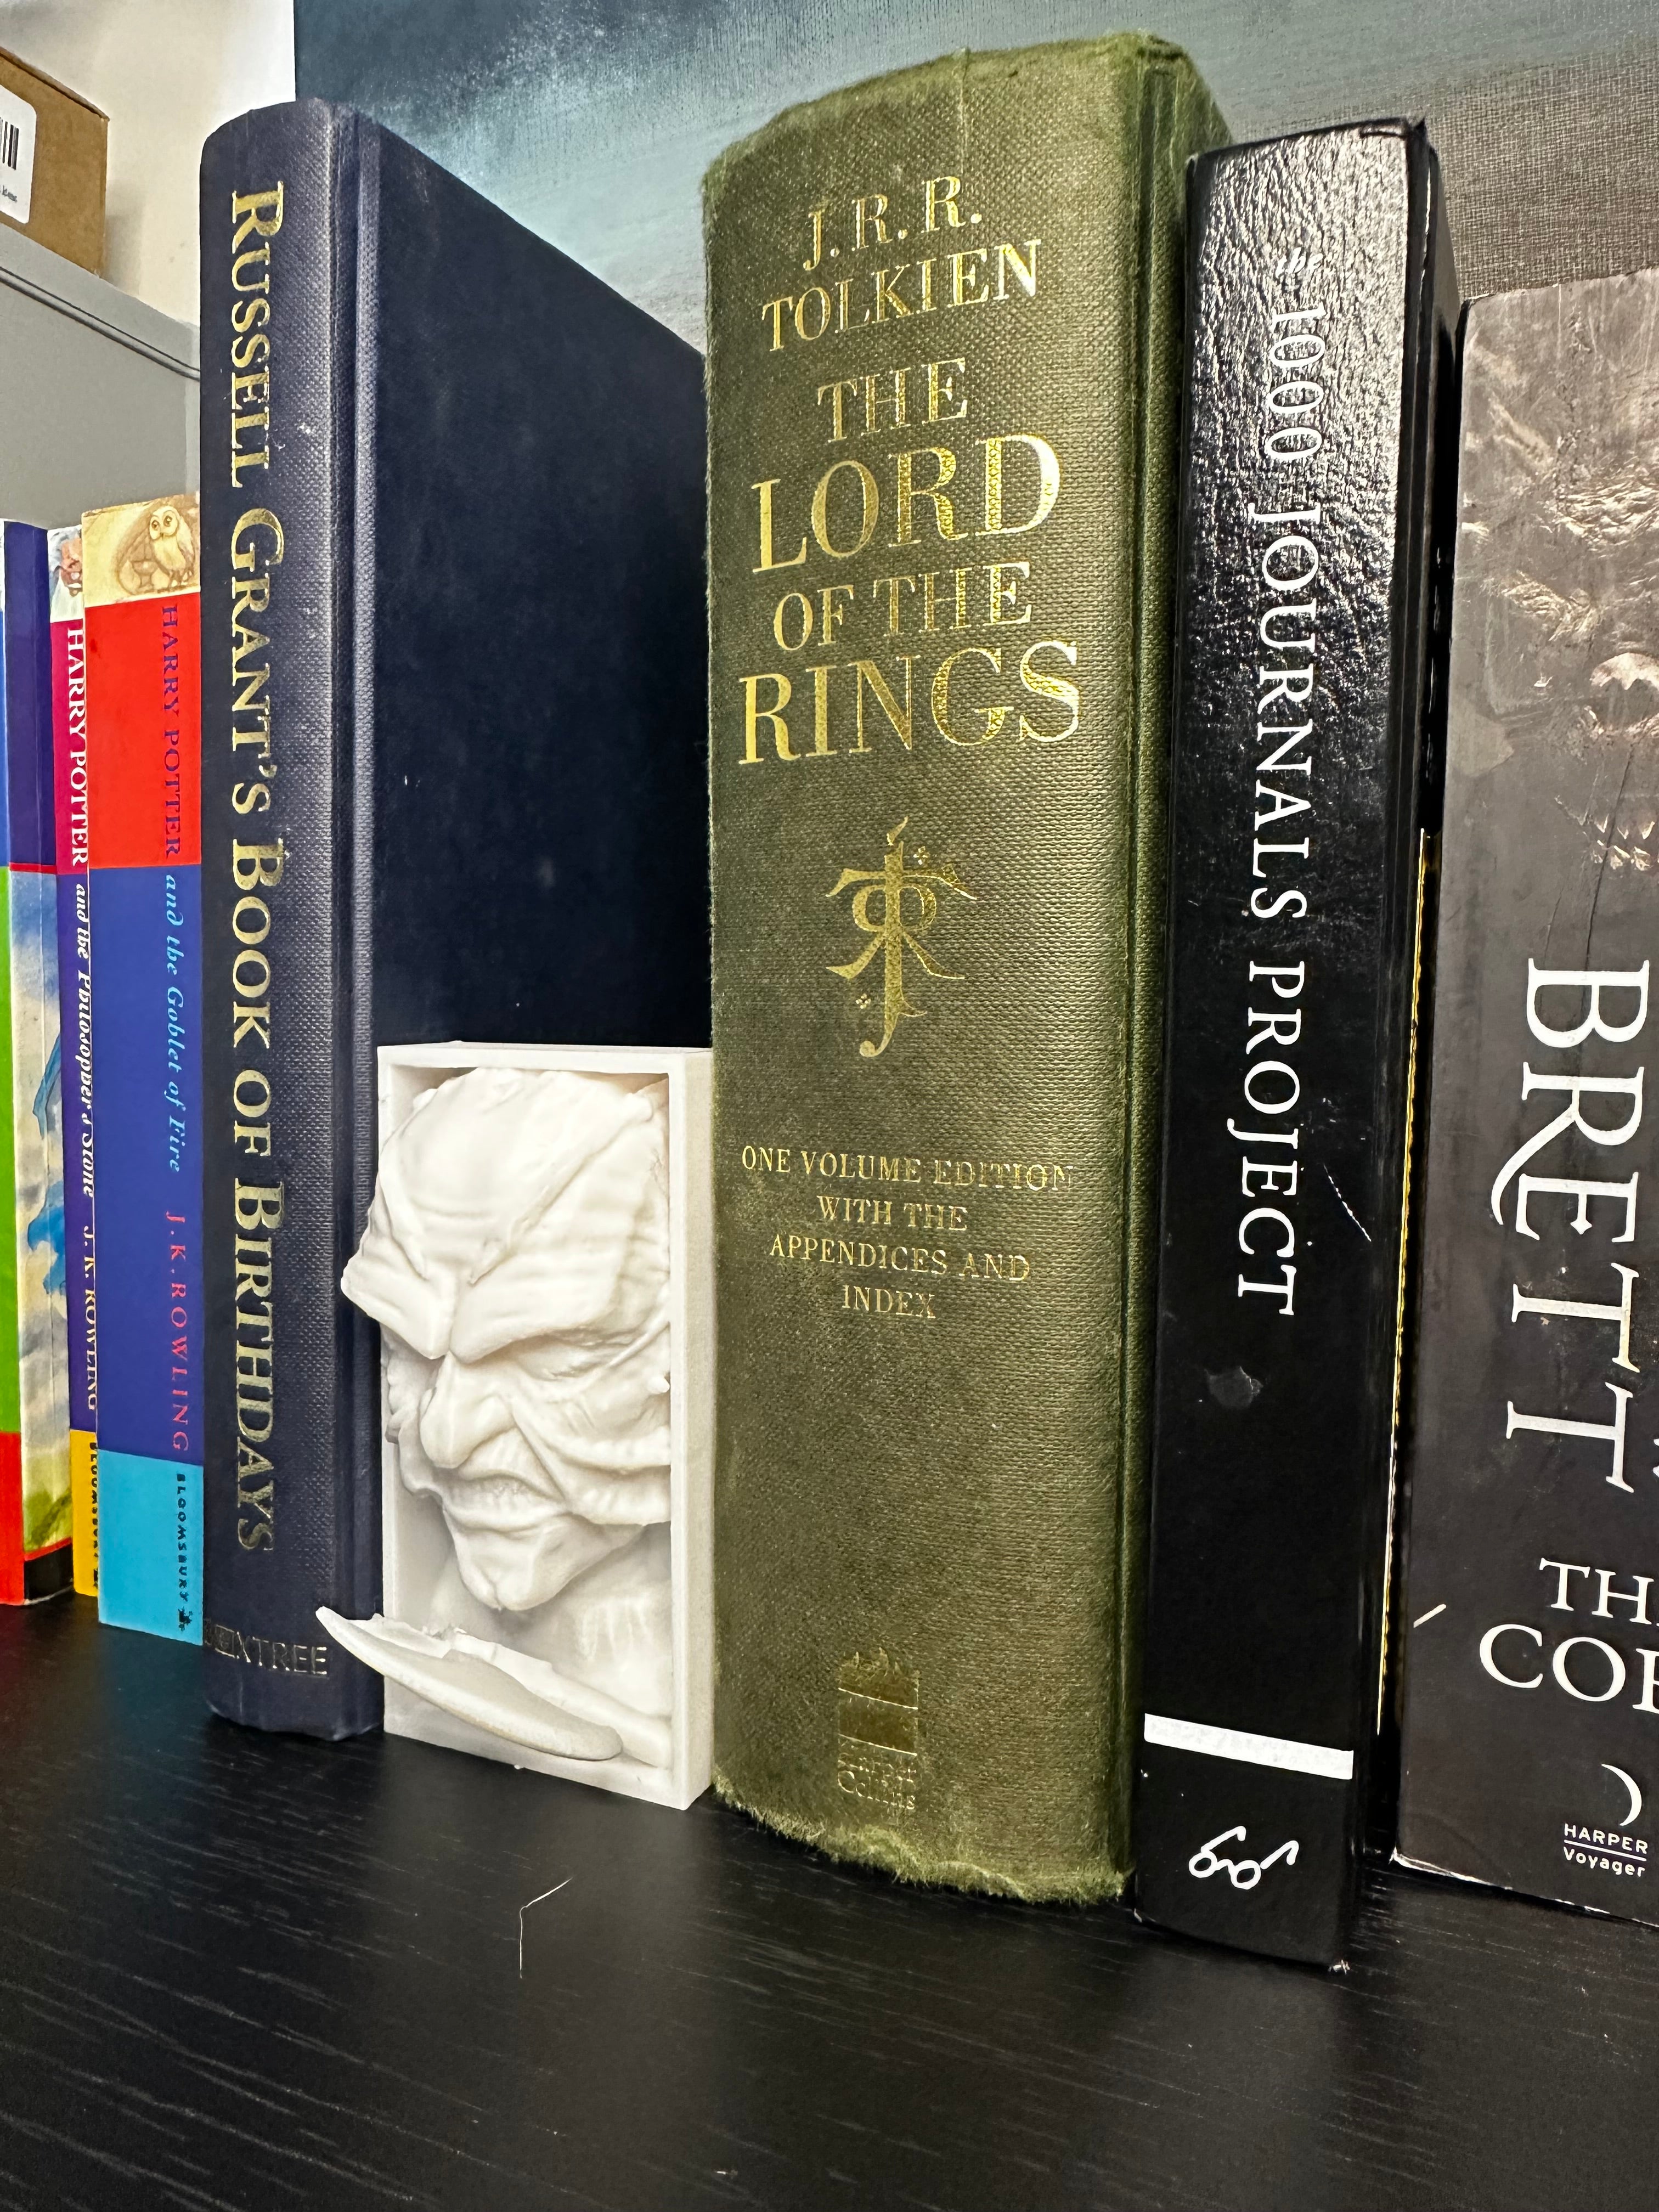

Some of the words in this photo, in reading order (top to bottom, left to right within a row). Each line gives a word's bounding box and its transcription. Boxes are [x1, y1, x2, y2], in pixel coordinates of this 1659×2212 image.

[232, 181, 284, 488] RUSSELL
[761, 238, 1041, 352] TOLKIEN
[817, 357, 969, 443] THE
[1266, 308, 1328, 464] 1000
[751, 433, 1060, 574] LORD
[774, 584, 854, 652] OF
[872, 561, 1032, 637] THE
[67, 628, 86, 749] HARRY
[162, 605, 179, 718] HARRY
[232, 508, 285, 814] GRANT'S
[738, 640, 1080, 765] RINGS
[1246, 501, 1319, 919] JOURNALS
[70, 751, 88, 867] POTTER
[165, 729, 181, 859] POTTER
[76, 883, 89, 923] and
[166, 874, 184, 926] and
[233, 839, 285, 1049] BOOK
[166, 936, 185, 976] the
[167, 986, 186, 1074] Goblet
[164, 1080, 186, 1112] of
[170, 1114, 187, 1173] Fire
[233, 1069, 271, 1157] OF
[1227, 960, 1306, 1316] PROJECT
[742, 1145, 791, 1173] ONE
[800, 1150, 922, 1183] VOLUME
[934, 1159, 1075, 1191] EDITION
[816, 1195, 892, 1225] WITH
[904, 1202, 968, 1231] THE
[769, 1233, 948, 1274] APPENDICES
[958, 1252, 1030, 1281] AND
[1491, 958, 1650, 1493] BRETT
[841, 1284, 936, 1319] INDEX
[235, 1178, 285, 1551] BIRTHDAYS
[176, 1472, 189, 1602] BLOOMSBURY
[1539, 1557, 1659, 1627] TH
[1564, 1822, 1648, 1855] HARPER
[1564, 1846, 1646, 1878] Voyager
